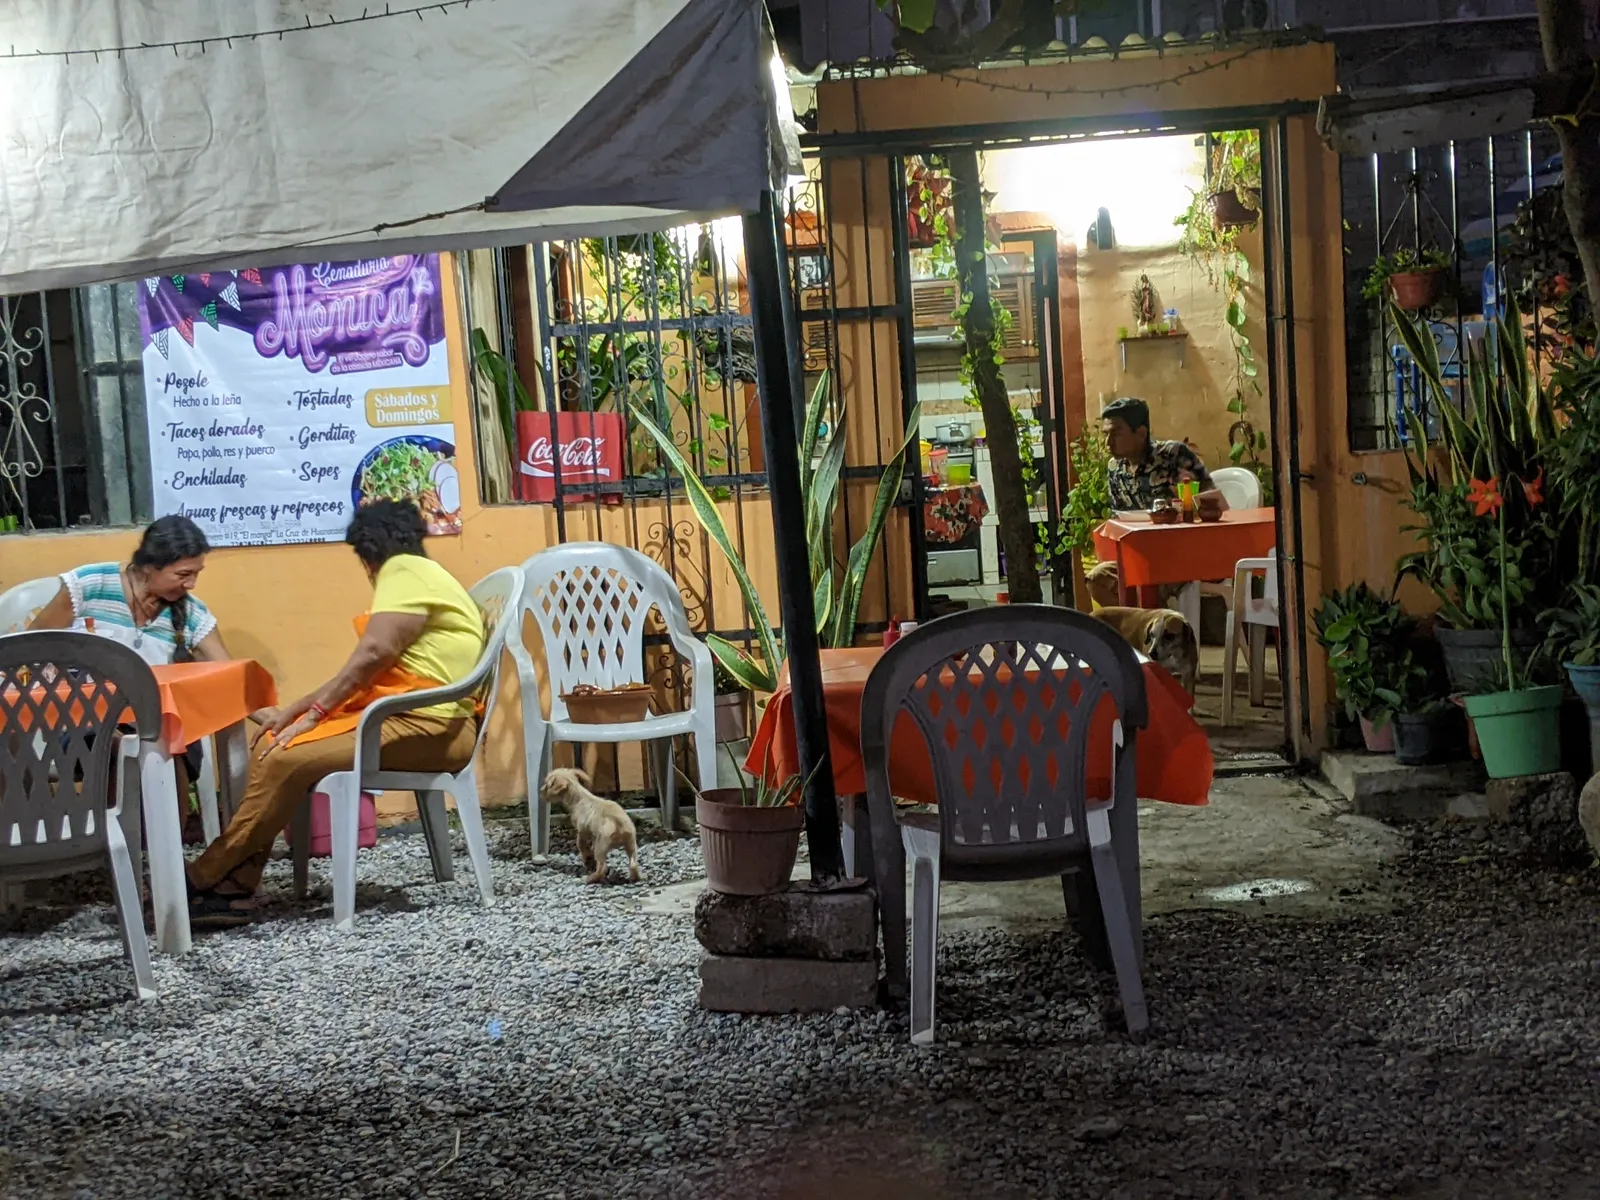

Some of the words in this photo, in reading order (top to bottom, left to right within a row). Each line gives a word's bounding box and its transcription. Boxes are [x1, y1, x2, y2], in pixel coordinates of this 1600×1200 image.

[164, 369, 209, 394] Pozole
[173, 395, 200, 408] Hecho
[202, 397, 209, 406] a
[211, 394, 219, 406] la
[222, 393, 242, 406] leña
[293, 387, 354, 411] Tostadas
[431, 393, 438, 408] y
[376, 408, 440, 424] Domingos
[166, 421, 206, 442] Tacos
[208, 417, 265, 439] dorados
[298, 422, 357, 449] Gorditas
[177, 447, 201, 462] Papa,
[201, 445, 223, 461] pollo,
[223, 447, 236, 457] res
[237, 447, 243, 459] y
[245, 445, 276, 459] puerco
[171, 466, 248, 490] Enchiladas
[299, 461, 341, 483] Sopes
[219, 504, 268, 523] frescas
[270, 506, 280, 521] y
[281, 501, 345, 521] refrescos
[285, 528, 300, 538] Cruz
